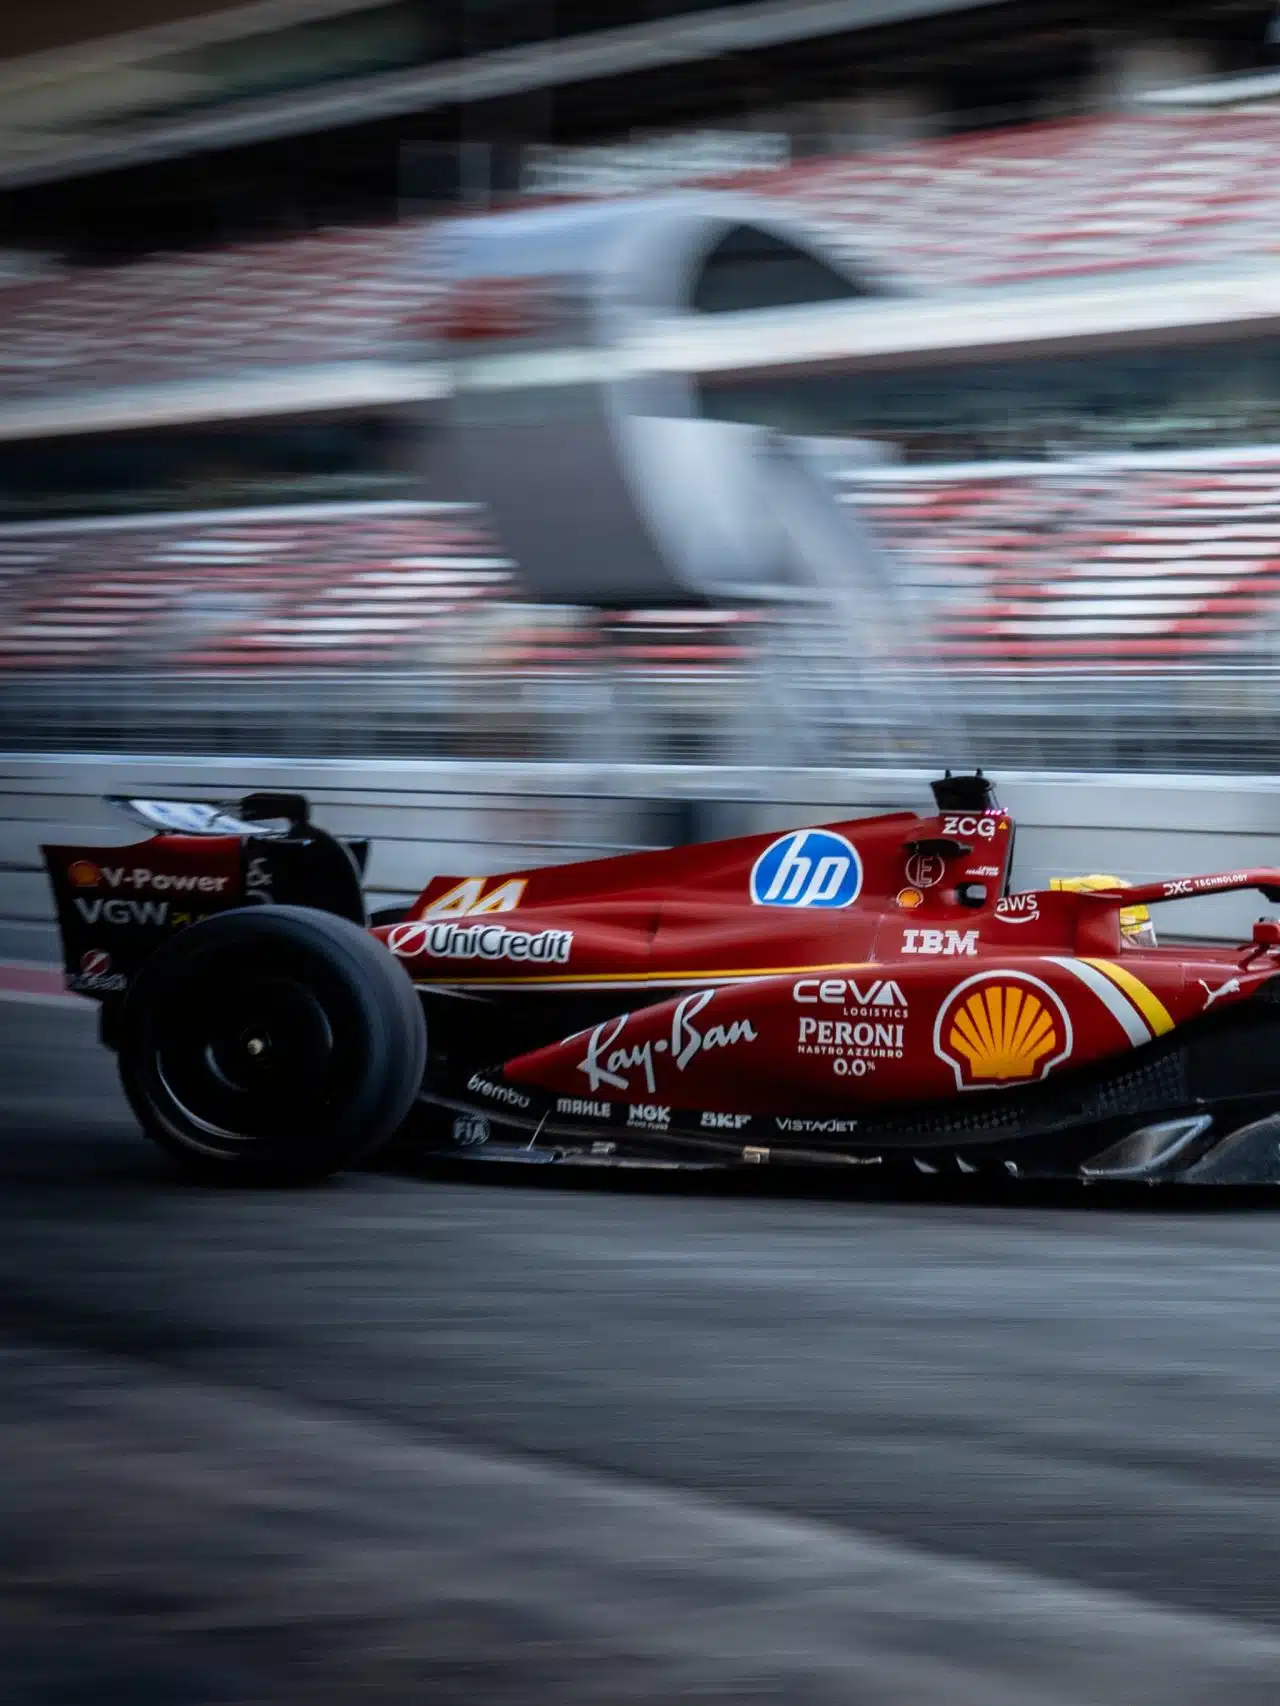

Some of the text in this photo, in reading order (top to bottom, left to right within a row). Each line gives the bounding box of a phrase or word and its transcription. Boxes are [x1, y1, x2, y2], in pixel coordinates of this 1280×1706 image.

[942, 816, 996, 837] ZCG
[101, 866, 228, 892] V-Power
[763, 829, 851, 907] hp
[1194, 873, 1248, 888] TECHNOLOGY
[421, 876, 529, 921] 44
[997, 894, 1038, 912] aws
[73, 897, 169, 926] VGW
[431, 926, 571, 961] UniCredit
[901, 929, 980, 955] IBM
[844, 1007, 909, 1018] LOGISTICS
[798, 1017, 904, 1047] PERONI
[798, 1046, 903, 1058] NASTRO AZZURRO
[467, 1073, 530, 1108] brembo
[629, 1103, 671, 1123] NGK
[700, 1111, 752, 1129] SKF
[454, 1122, 488, 1141] FIA
